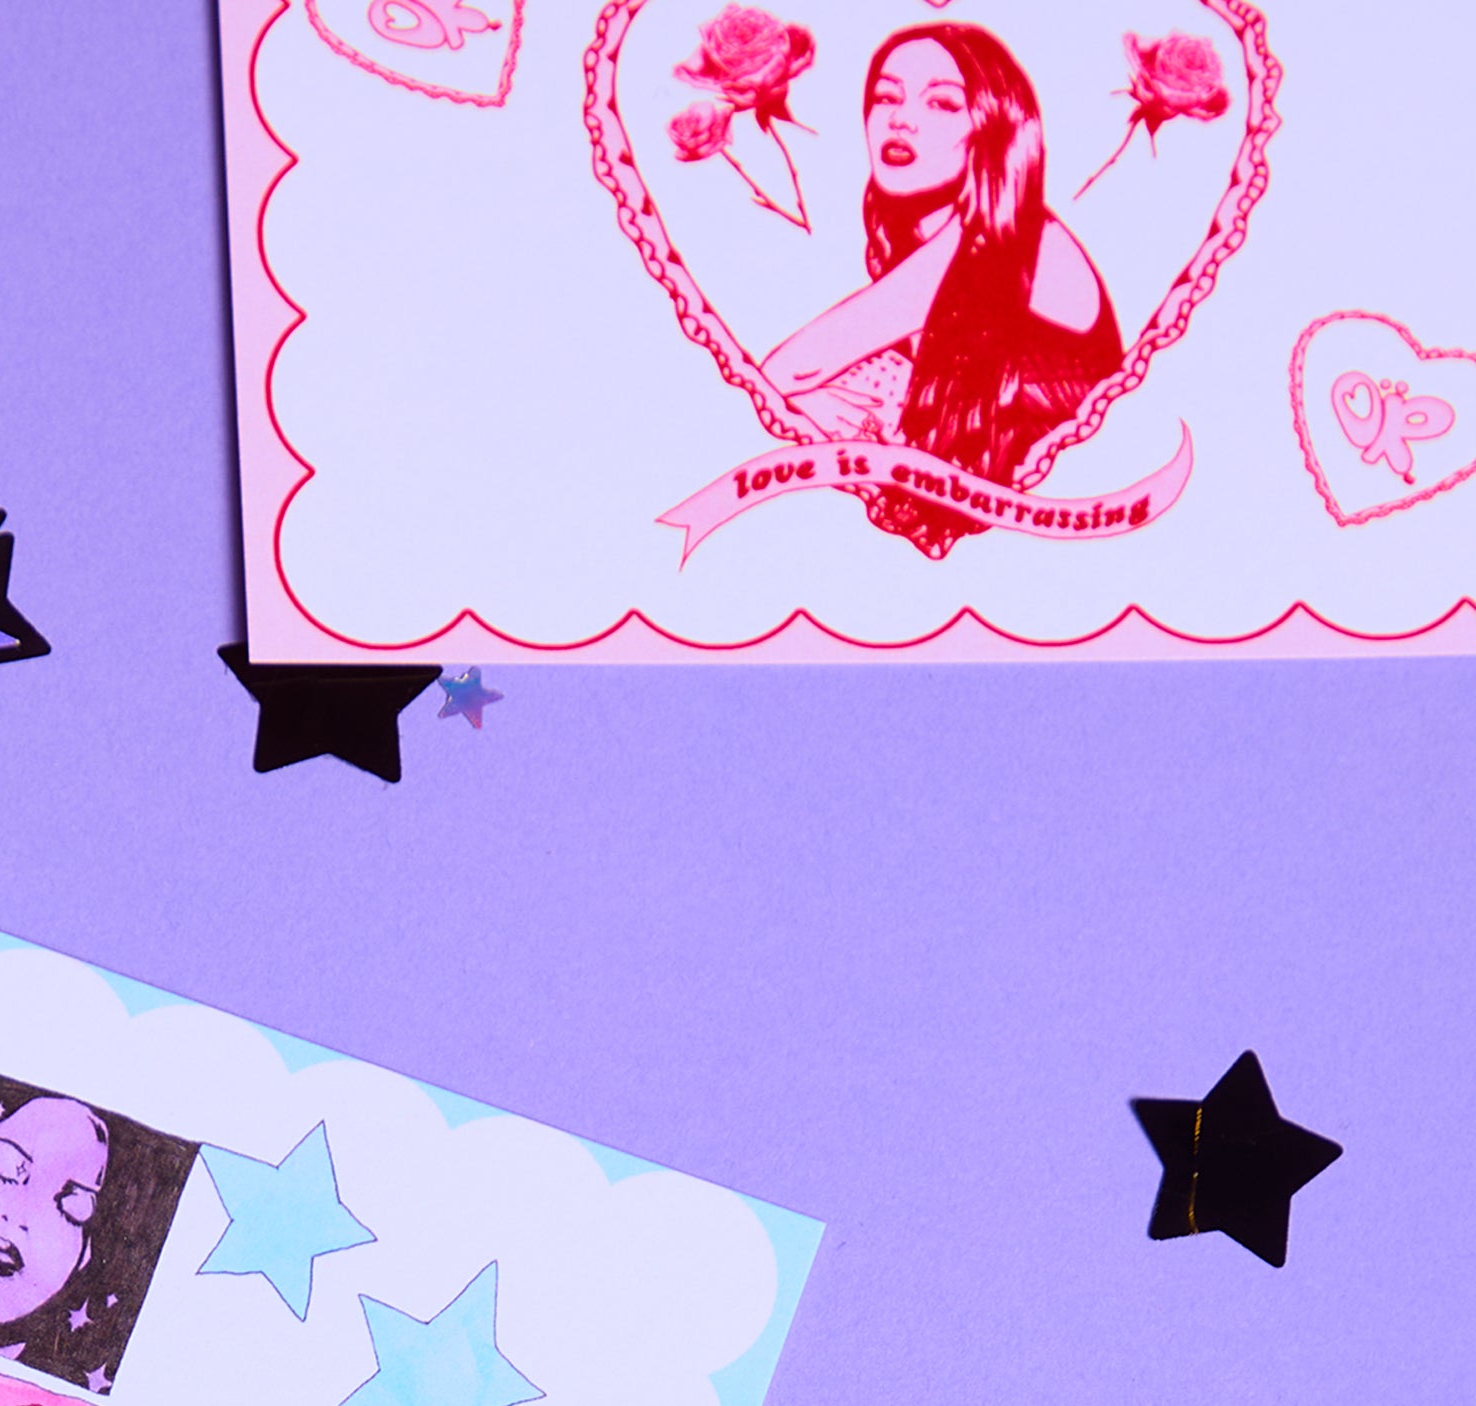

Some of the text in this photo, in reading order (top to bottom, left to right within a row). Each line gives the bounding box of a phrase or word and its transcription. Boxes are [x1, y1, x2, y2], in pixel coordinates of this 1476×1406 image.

[733, 447, 1151, 531] love is embarrassing
